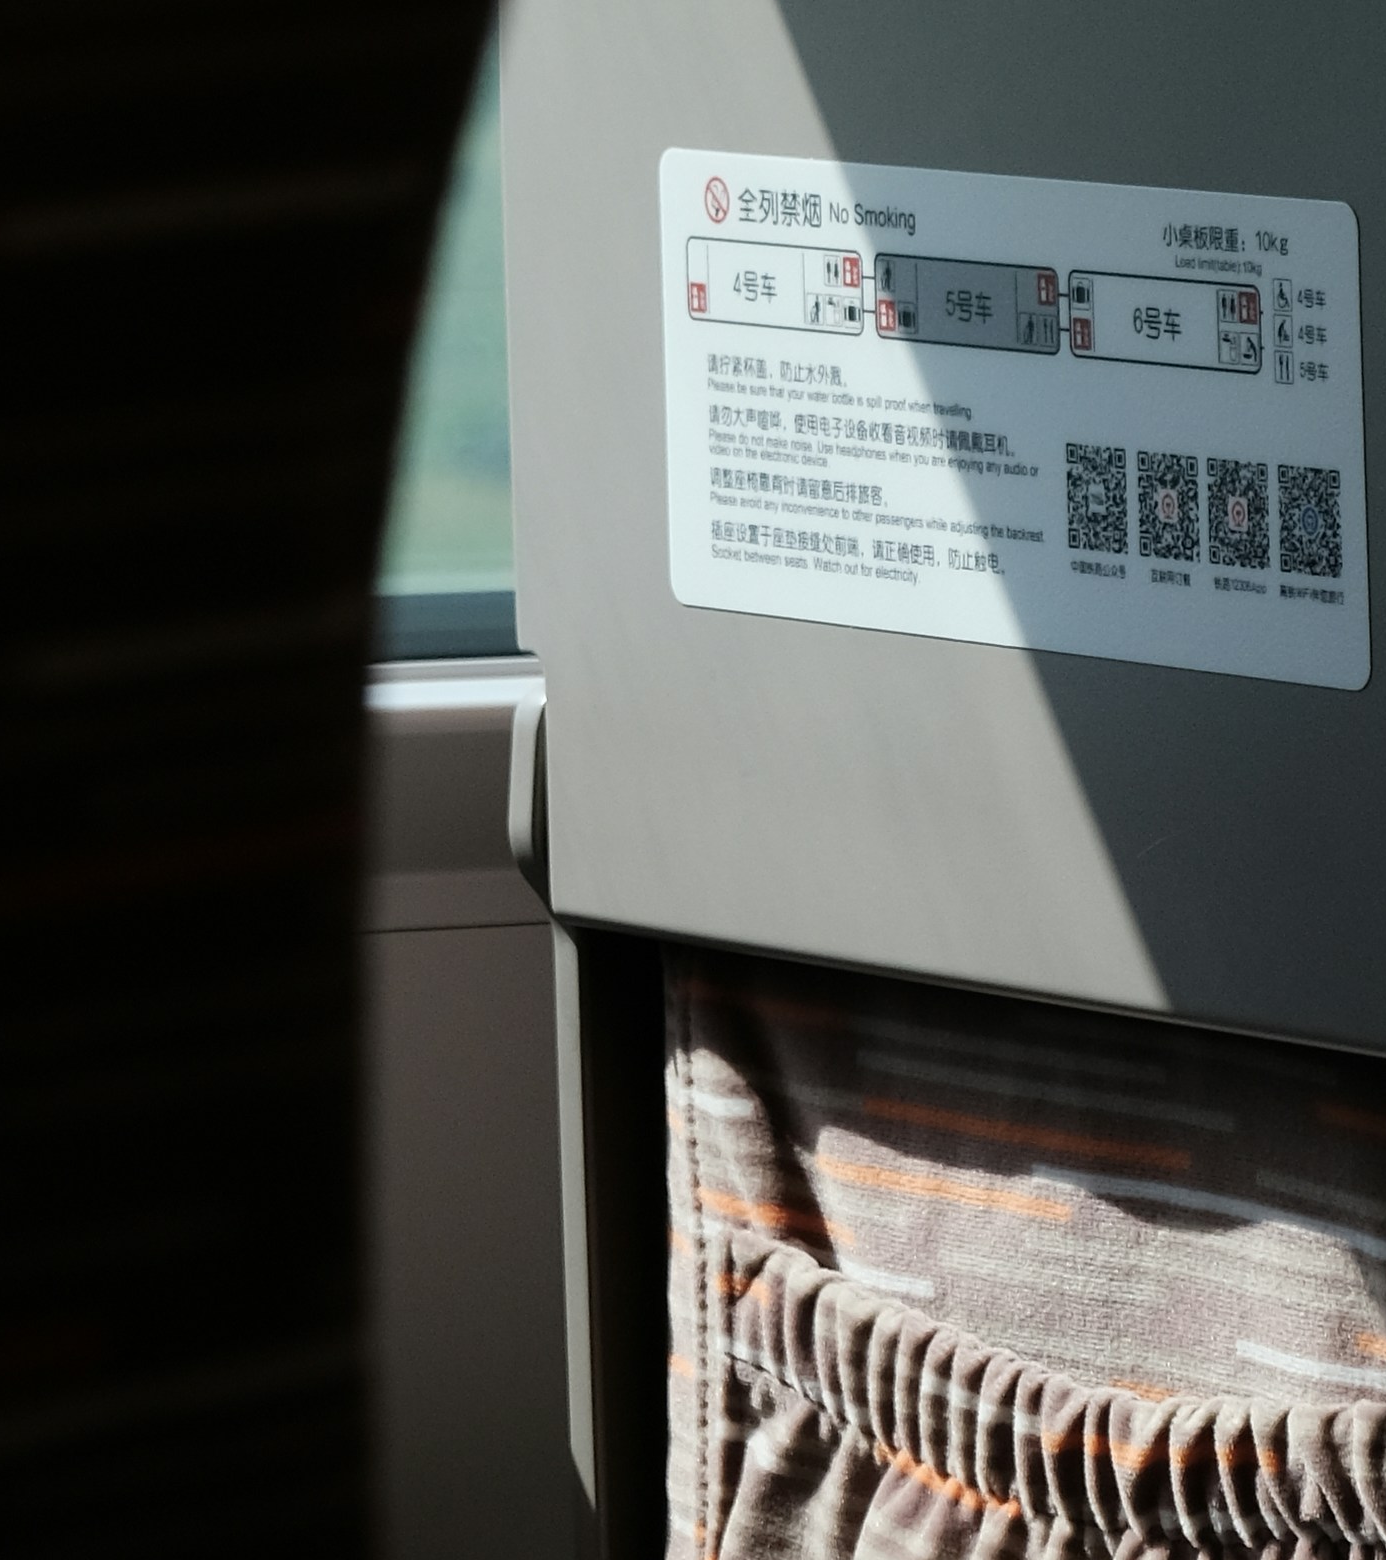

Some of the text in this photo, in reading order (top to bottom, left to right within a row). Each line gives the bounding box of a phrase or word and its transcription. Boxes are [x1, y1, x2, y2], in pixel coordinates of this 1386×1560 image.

[738, 188, 916, 236] 全列禁烟 No Smoking
[1174, 255, 1195, 269] Load
[733, 270, 777, 302] 4号车
[1297, 288, 1326, 308] 4号车
[945, 290, 993, 323] 5号车
[1133, 306, 1181, 340] 6号车
[1297, 324, 1327, 345] 4号车
[1299, 361, 1328, 382] 5号车
